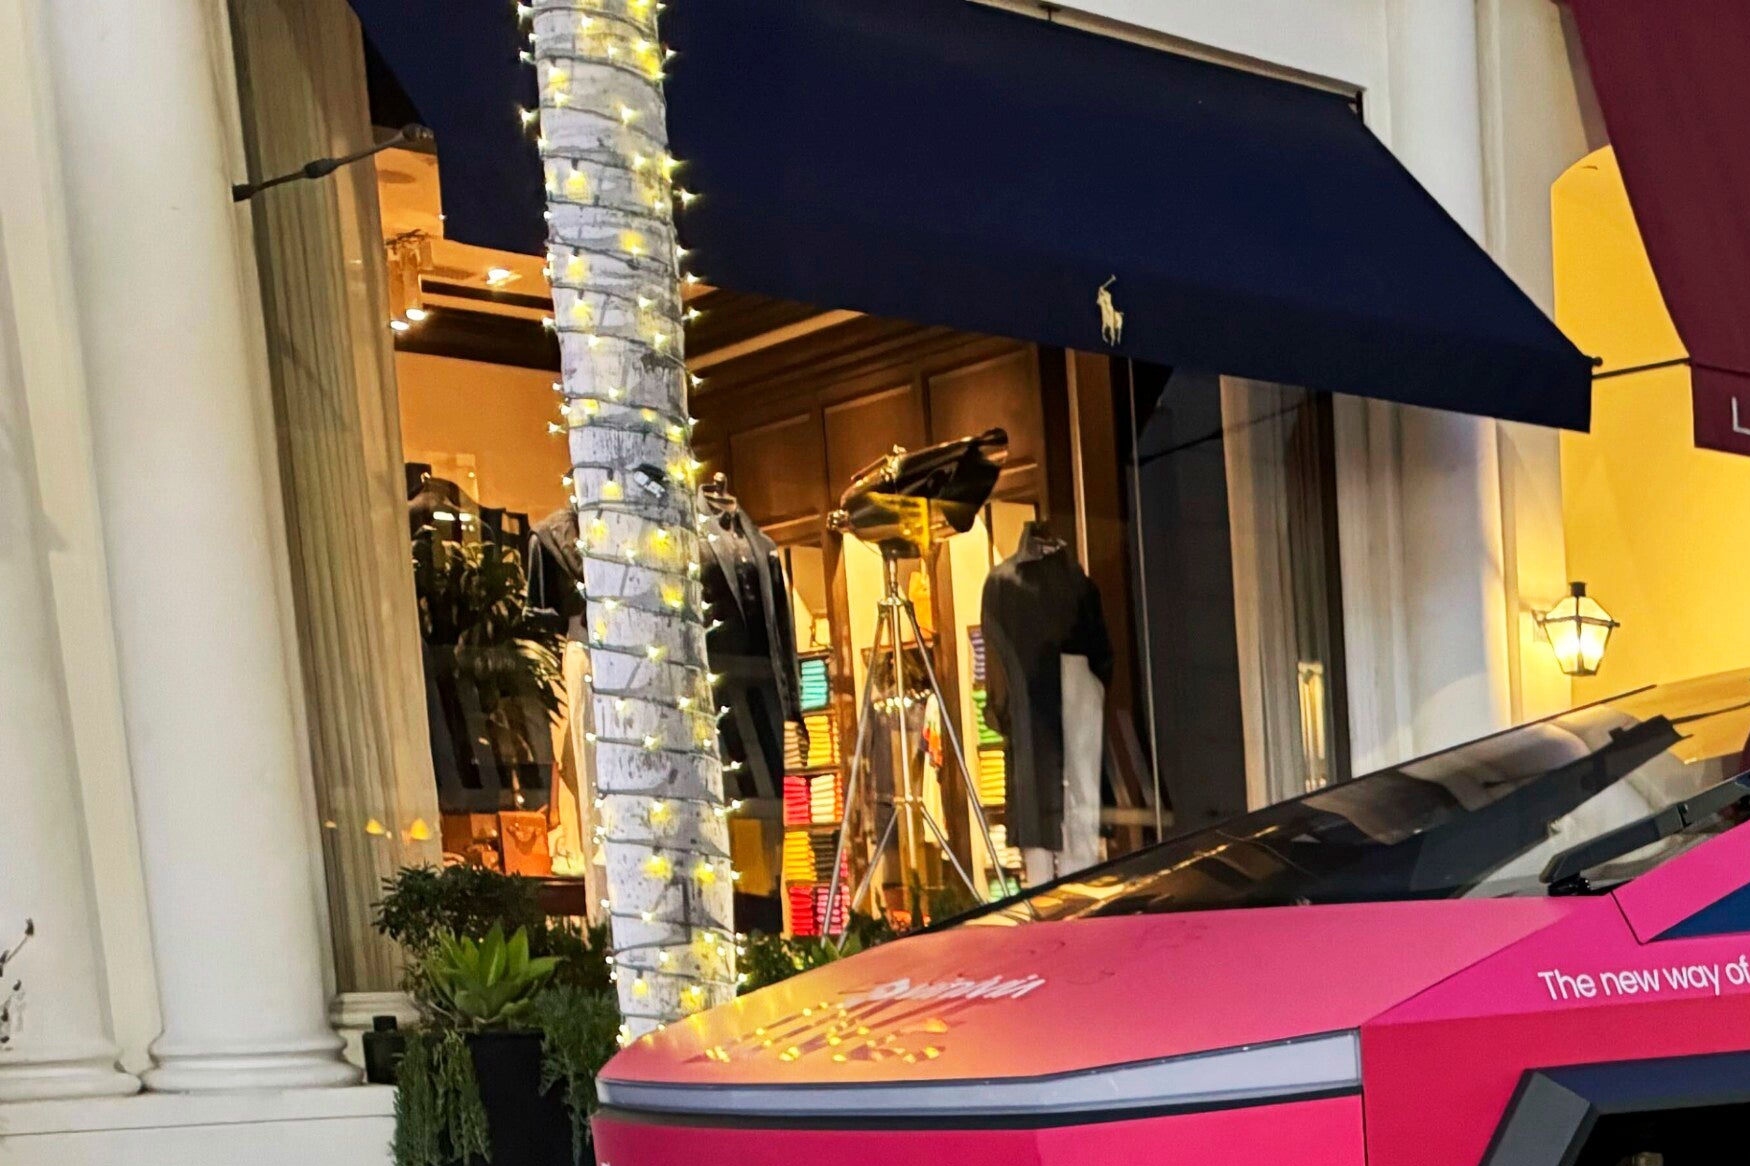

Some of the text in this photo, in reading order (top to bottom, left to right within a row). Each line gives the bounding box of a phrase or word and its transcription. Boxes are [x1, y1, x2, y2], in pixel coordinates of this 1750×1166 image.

[1537, 969, 1597, 1001] The
[1600, 968, 1659, 997] new
[1663, 963, 1720, 996] way
